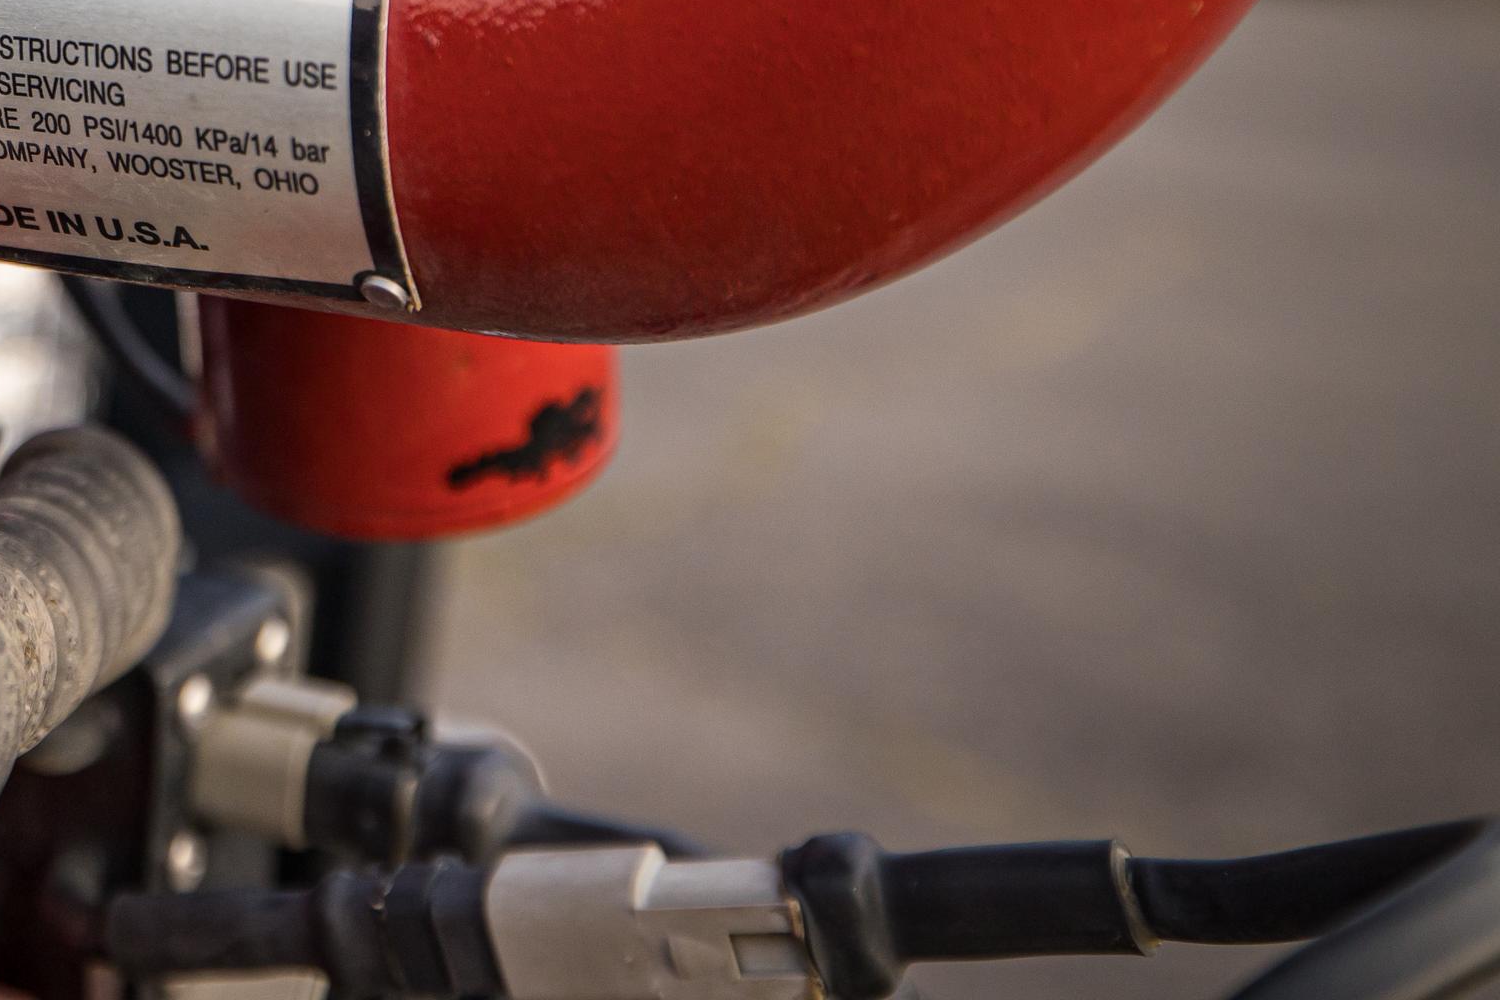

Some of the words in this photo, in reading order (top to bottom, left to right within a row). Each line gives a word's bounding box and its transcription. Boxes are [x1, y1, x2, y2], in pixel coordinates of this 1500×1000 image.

[167, 49, 269, 84] BEFORE
[284, 60, 336, 90] USE
[31, 111, 71, 135] 200
[83, 115, 182, 147] PSI/1400
[195, 127, 278, 157] KPa/14
[291, 137, 329, 163] bar
[107, 151, 241, 190] WOOSTER,
[254, 168, 319, 195] OHIO
[46, 210, 87, 236] IN
[95, 216, 209, 251] U.S.A.
